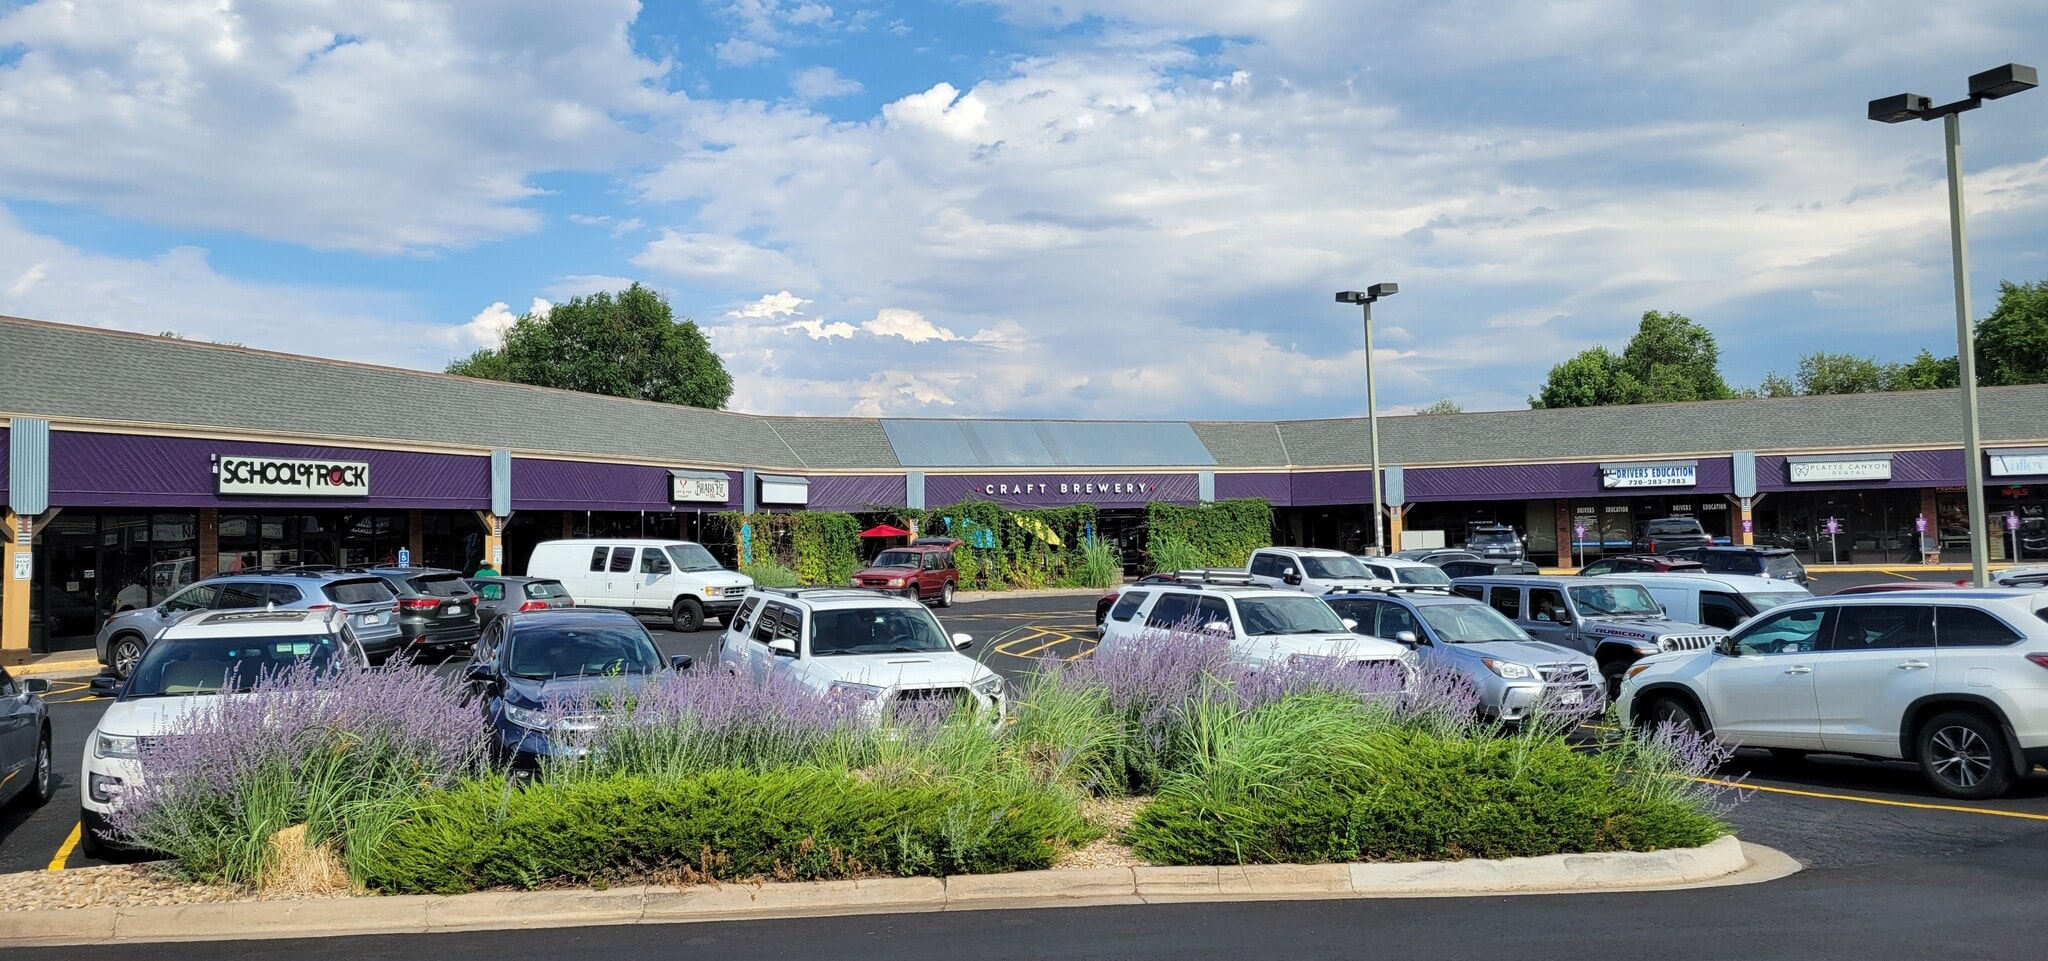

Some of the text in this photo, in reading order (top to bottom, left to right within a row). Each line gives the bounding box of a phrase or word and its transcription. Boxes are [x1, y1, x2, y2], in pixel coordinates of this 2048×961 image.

[1616, 465, 1694, 478] DRIVERS EDUCATION
[1810, 462, 1888, 471] PLATTE CANYON
[222, 460, 301, 485] SCHOOL
[315, 464, 366, 487] ROCK
[1628, 478, 1686, 486] 720-283-7483
[985, 483, 1146, 495] CRAFT BREWERY
[1702, 503, 1727, 511] EDUCATION
[1595, 628, 1646, 638] RUBICON
